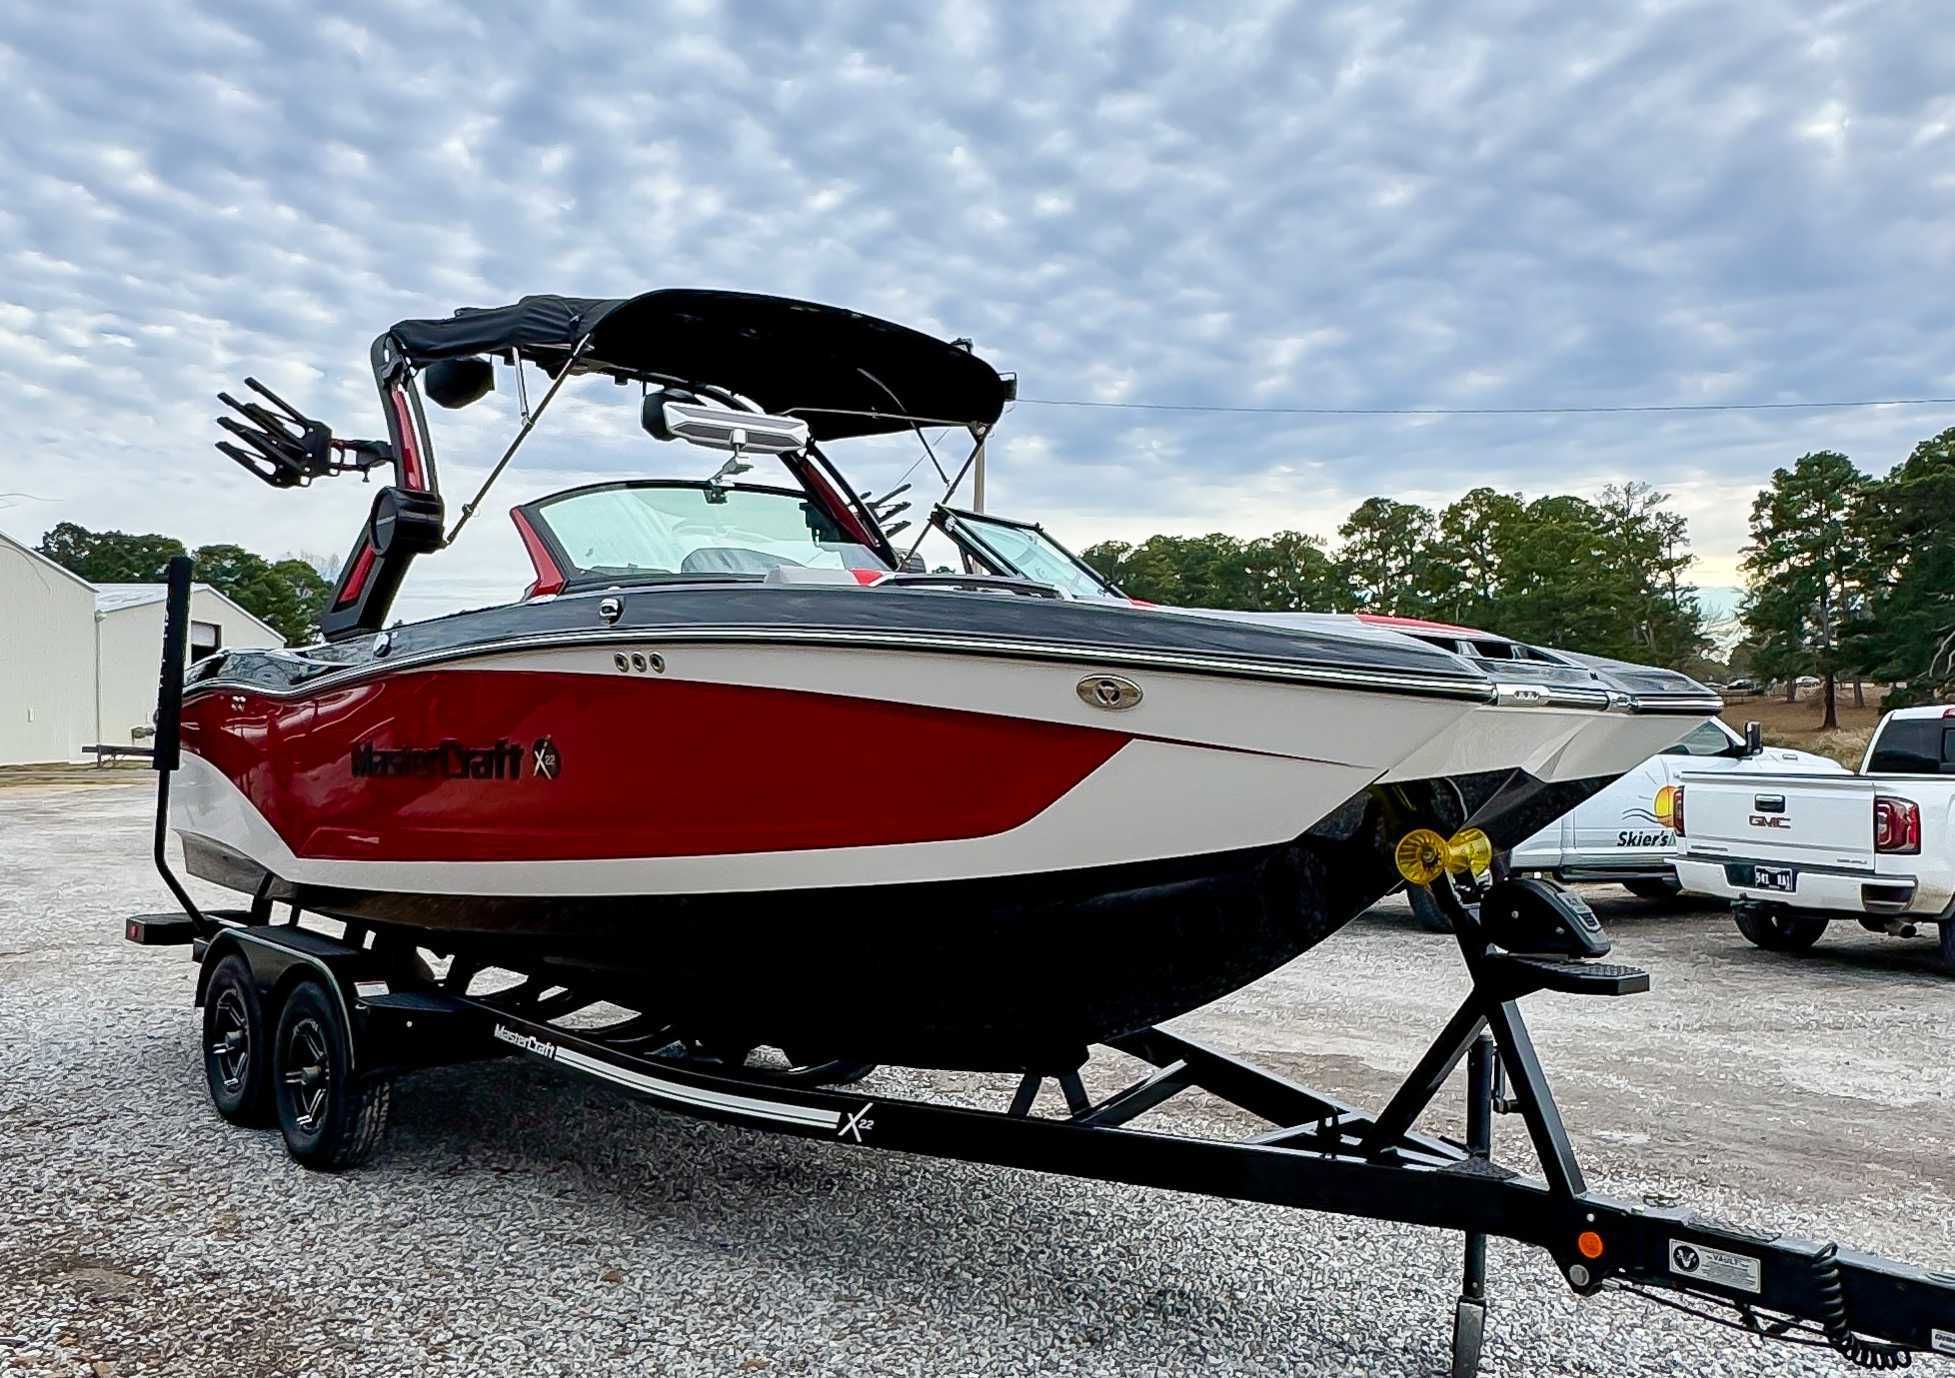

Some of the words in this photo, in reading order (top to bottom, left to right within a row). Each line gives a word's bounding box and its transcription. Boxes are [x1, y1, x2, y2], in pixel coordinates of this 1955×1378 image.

[351, 738, 523, 779] MasterCraft
[1749, 815, 1791, 829] GMC
[1617, 830, 1668, 847] Skier's
[494, 1024, 555, 1058] MasterCraft
[838, 1103, 874, 1142] X22
